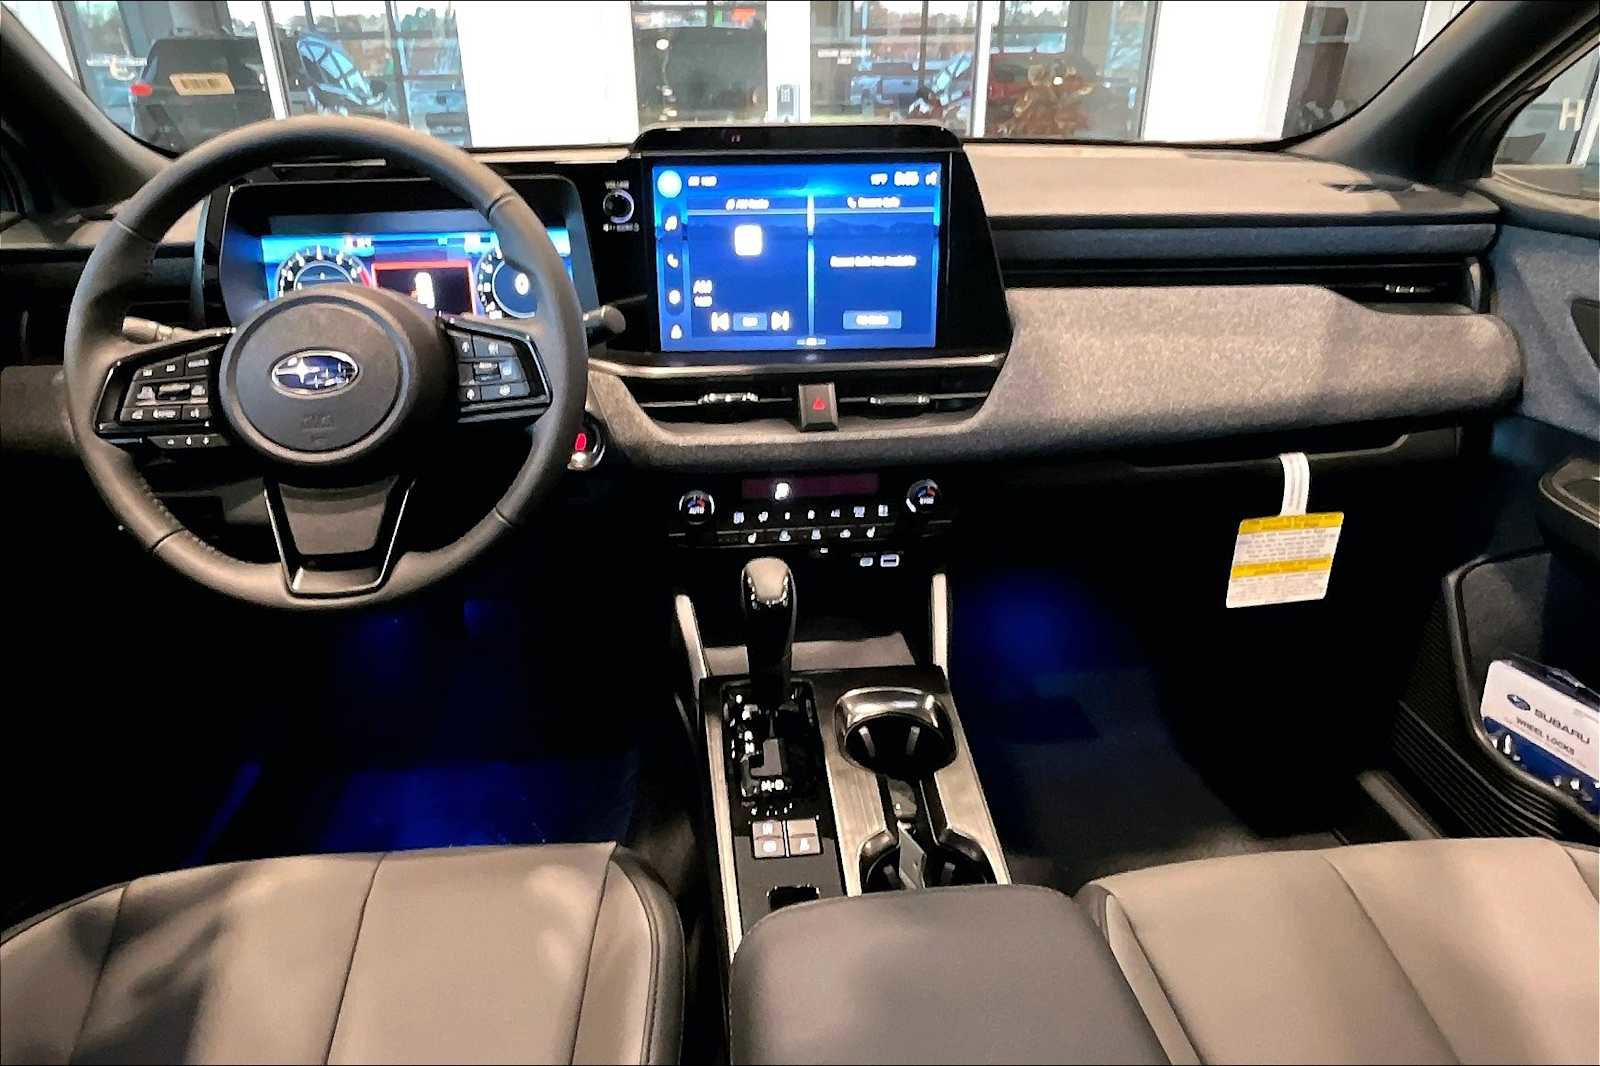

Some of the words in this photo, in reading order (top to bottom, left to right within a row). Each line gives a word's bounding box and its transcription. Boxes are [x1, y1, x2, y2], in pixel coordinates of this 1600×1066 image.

[1516, 716, 1543, 738] WHEEL
[1546, 734, 1575, 756] LOCKS
[1534, 708, 1590, 745] SUBARU
